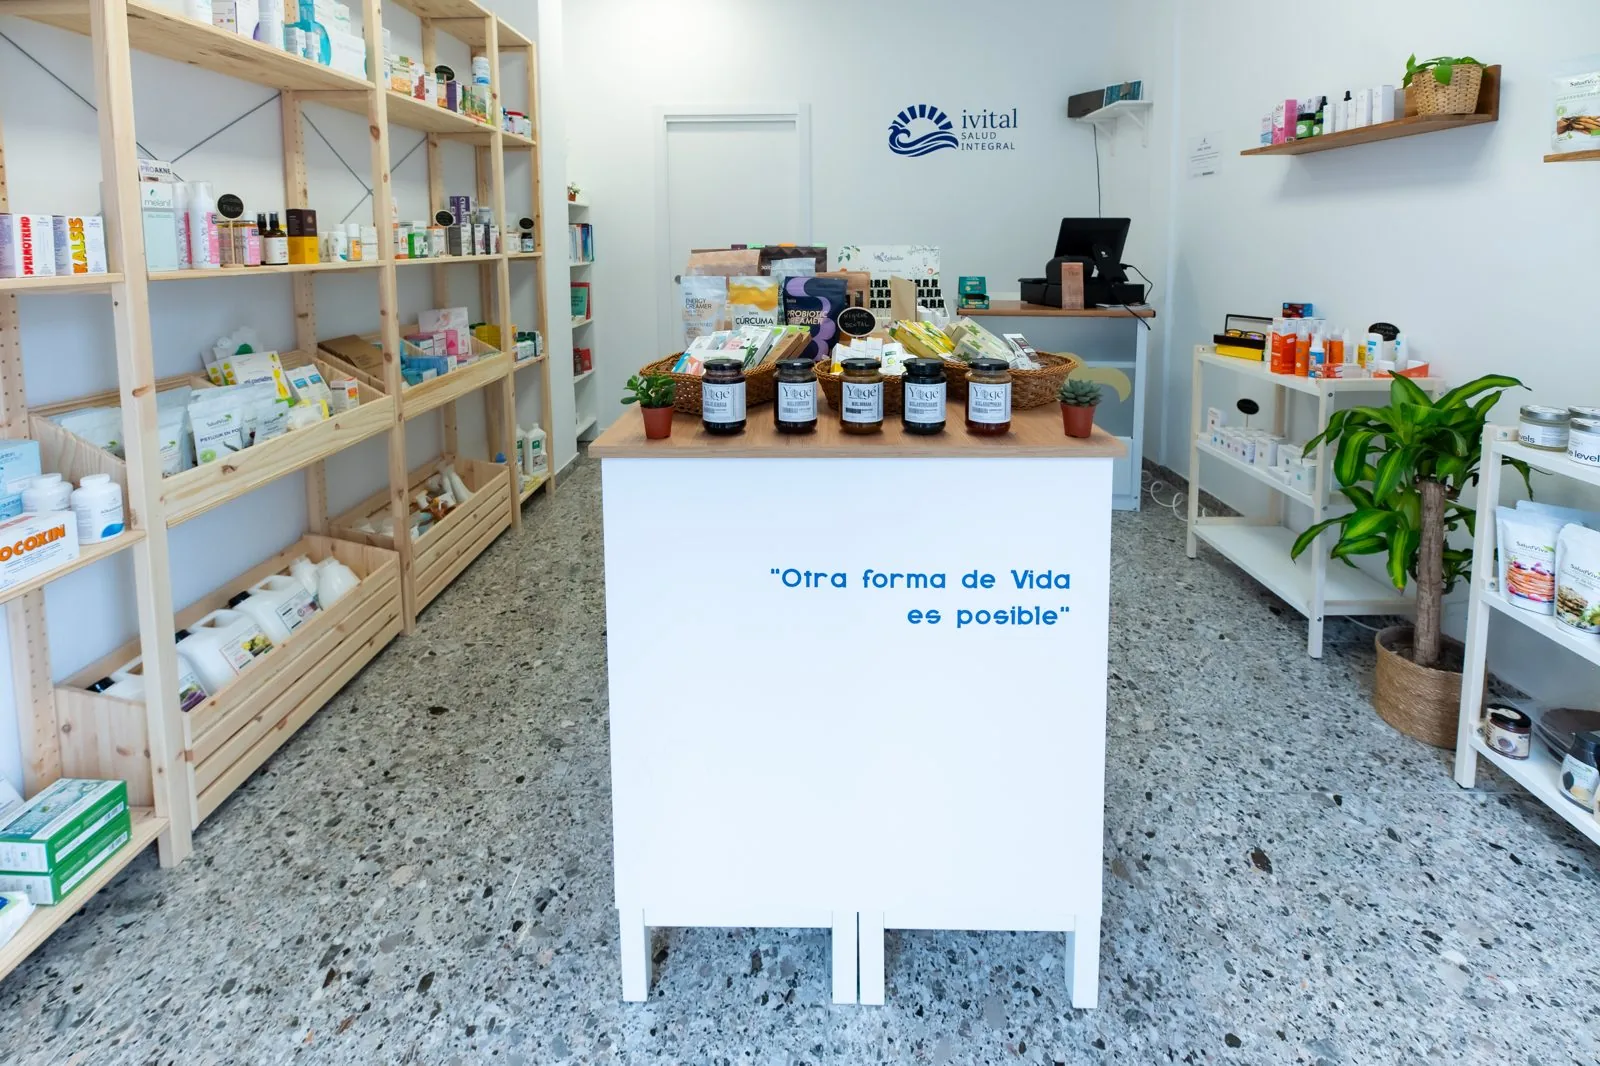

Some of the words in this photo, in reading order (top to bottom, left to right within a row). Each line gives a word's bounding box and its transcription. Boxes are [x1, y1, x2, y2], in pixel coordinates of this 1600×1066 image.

[961, 108, 1018, 129] ivital
[961, 132, 997, 141] SALUD
[961, 142, 1016, 151] INTEGRAL
[68, 217, 88, 274] KALSIS
[735, 315, 774, 325] CÚRCUMA
[0, 524, 66, 562] OCOXIN
[771, 568, 848, 588] "Otra
[862, 568, 946, 589] forma
[961, 569, 996, 589] de
[1010, 569, 1071, 589] Vida
[907, 608, 941, 624] es
[956, 605, 1070, 628] posible"
